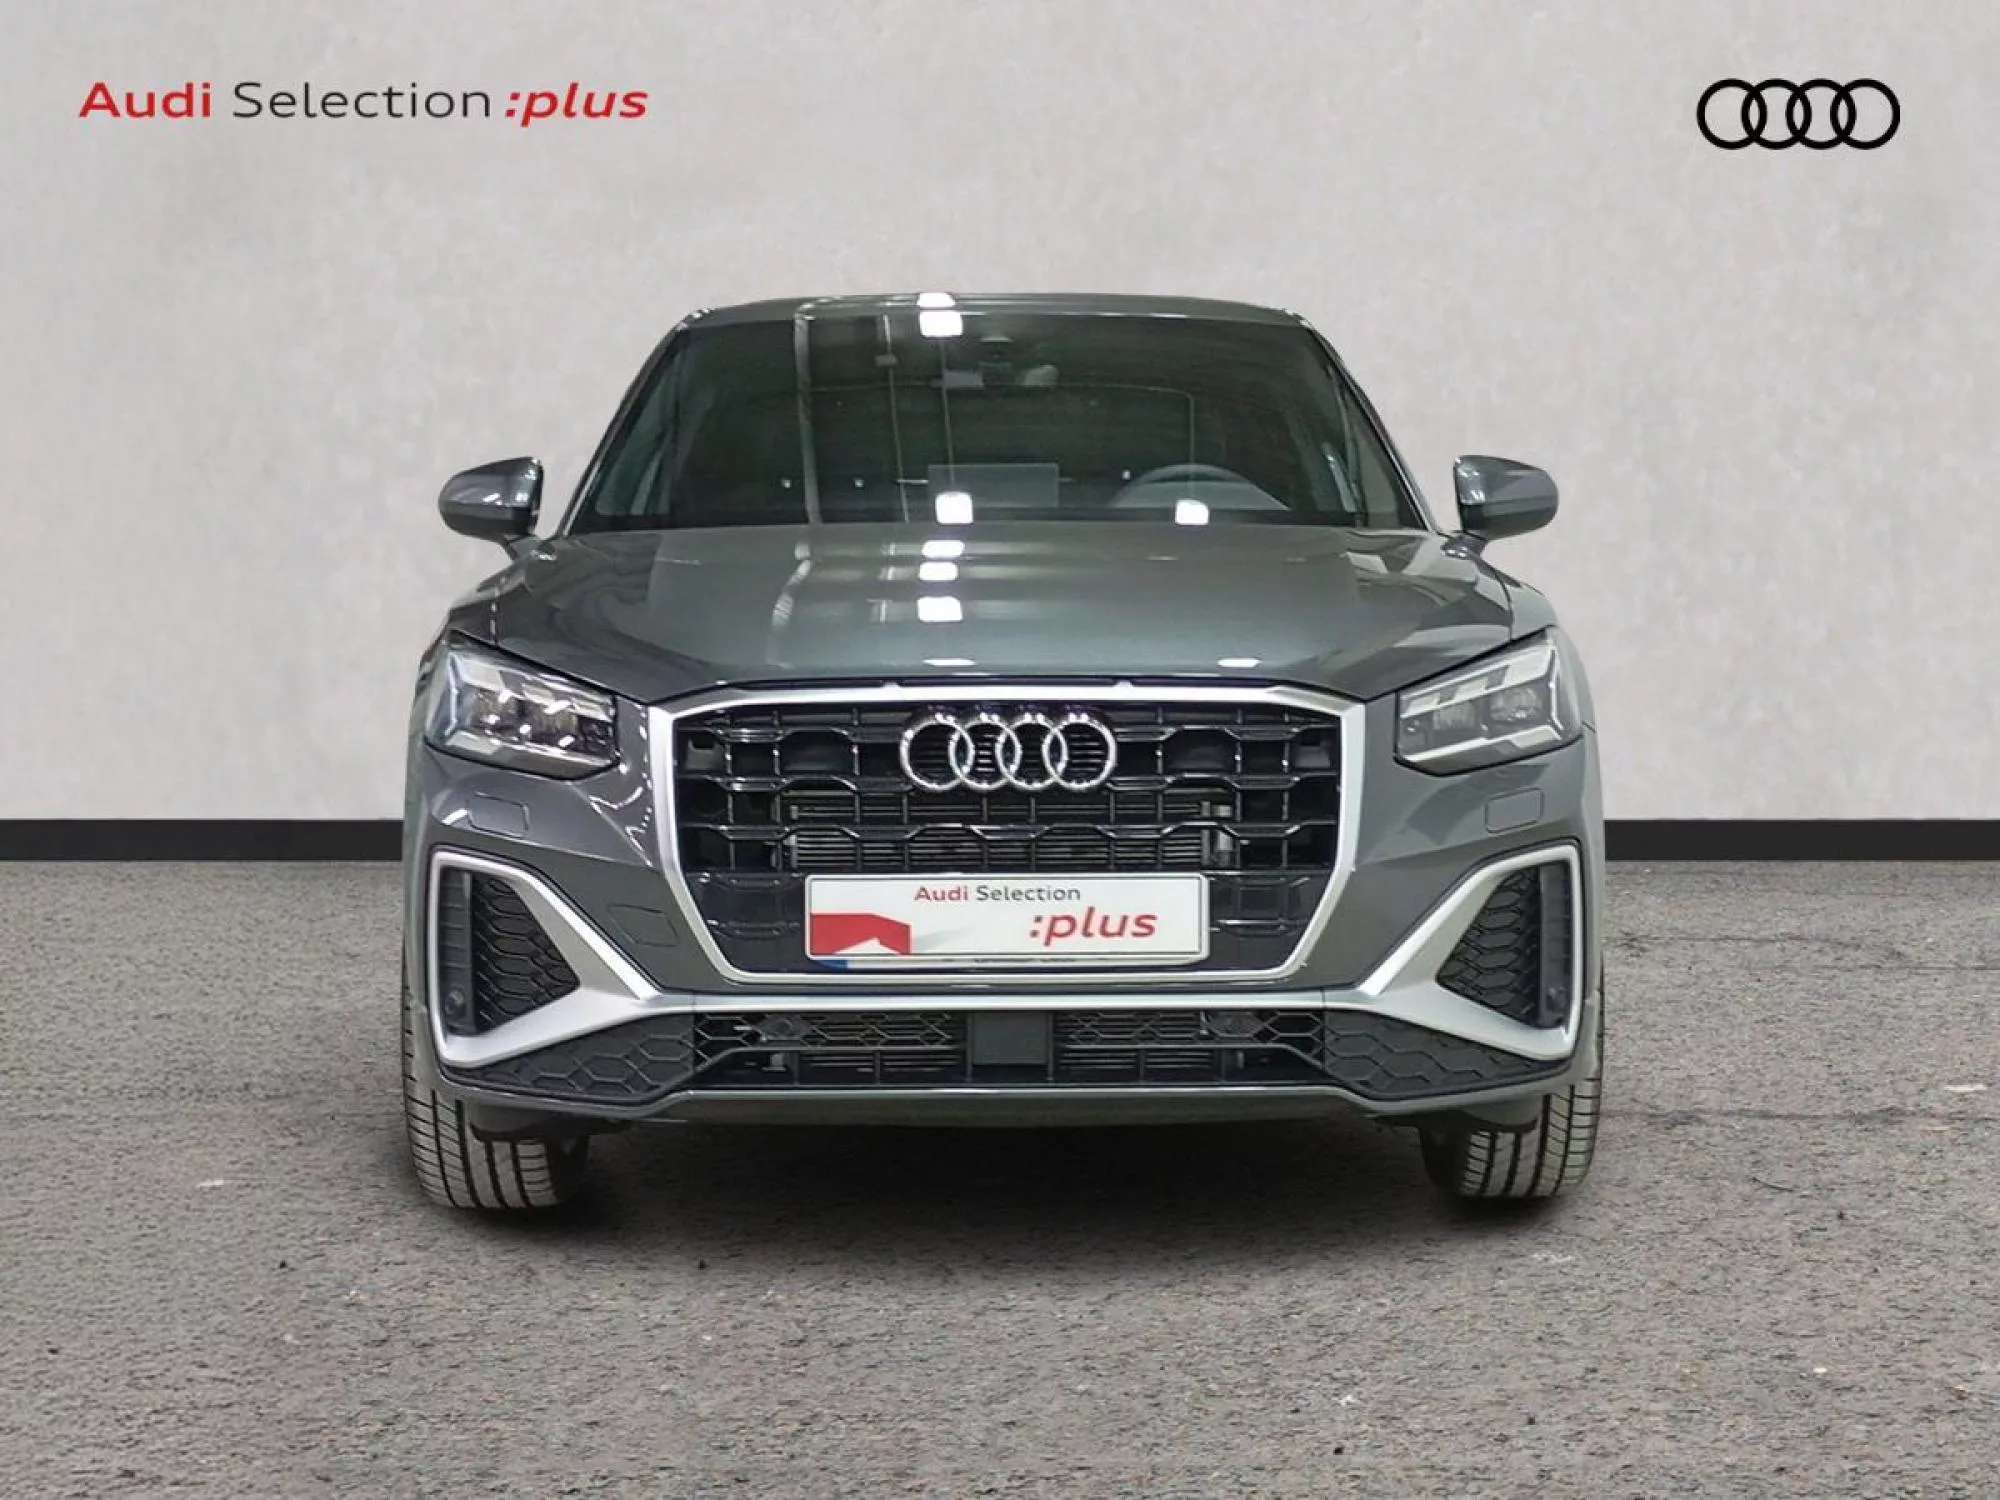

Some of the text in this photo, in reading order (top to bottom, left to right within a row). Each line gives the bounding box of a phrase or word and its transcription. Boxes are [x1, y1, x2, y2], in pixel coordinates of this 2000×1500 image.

[914, 885, 1081, 902] Audi Selection
[1029, 906, 1158, 947] :plus
